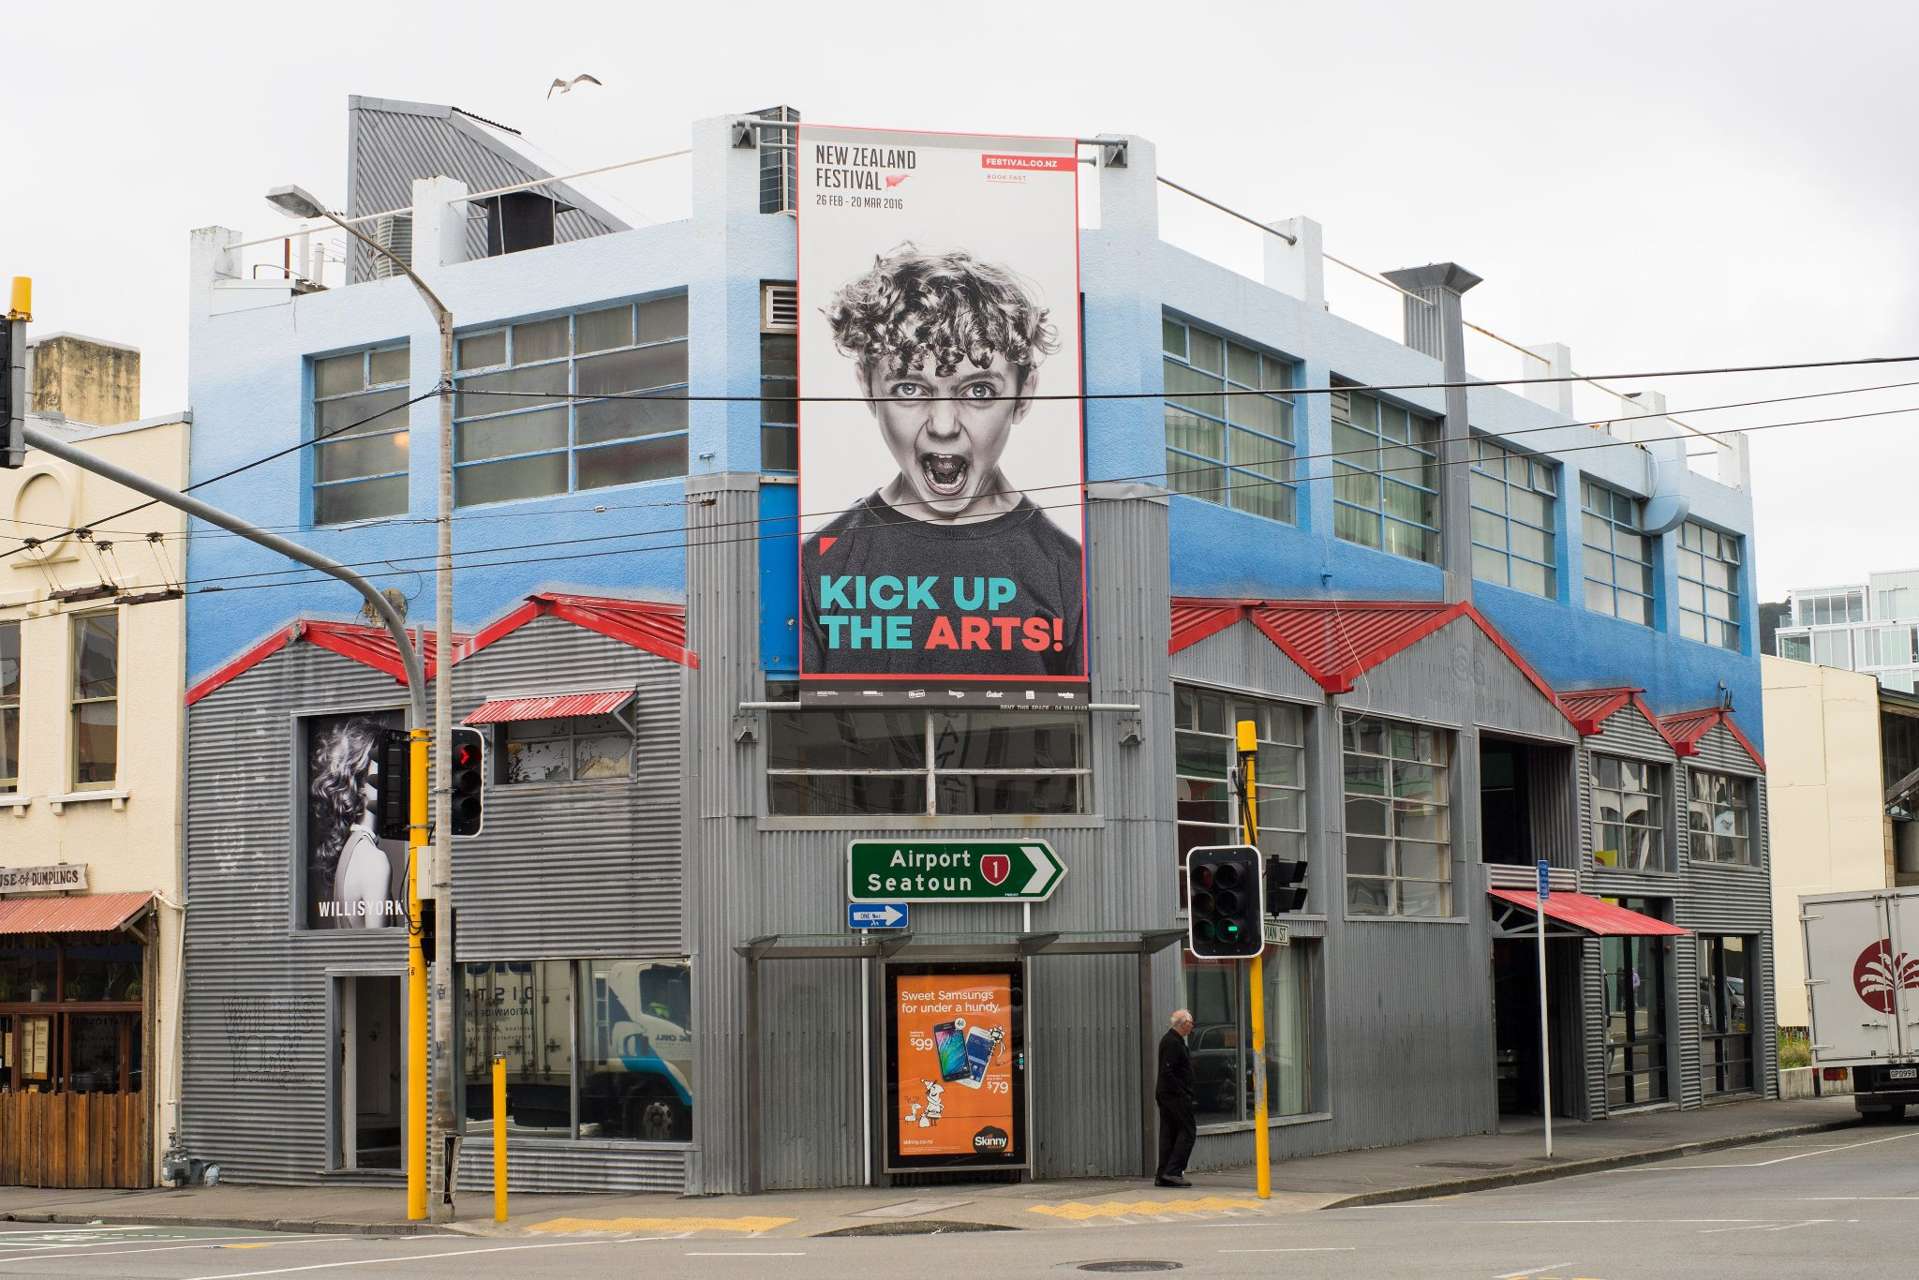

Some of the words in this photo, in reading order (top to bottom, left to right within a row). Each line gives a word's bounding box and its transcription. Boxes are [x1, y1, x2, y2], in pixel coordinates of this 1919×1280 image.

[816, 145, 849, 166] NEW
[853, 147, 916, 170] ZEALAND
[986, 158, 1058, 168] FESTIVAL.CO.NZ
[816, 167, 882, 191] FESTIVAL
[816, 194, 827, 206] 26
[829, 195, 844, 207] FEB
[851, 196, 862, 208] 20
[864, 197, 881, 208] MAR
[884, 198, 903, 210] 2016
[820, 575, 940, 610] KICK
[953, 576, 1017, 611] UP
[819, 615, 913, 650] THE
[924, 616, 1065, 652] ARTS!
[890, 850, 971, 871] Airport
[992, 860, 999, 879] 1
[32, 870, 79, 886] DUMPLINGS
[867, 873, 972, 892] Seatoun
[902, 991, 935, 1001] Sweet
[938, 990, 994, 1001] Samsungs
[902, 1003, 917, 1014] for
[921, 1002, 953, 1013] under
[955, 1004, 963, 1012] a
[965, 1002, 1001, 1013] hundy.
[910, 1037, 934, 1051] $99
[987, 1081, 1009, 1095] $79
[974, 1136, 1007, 1148] Skinny
